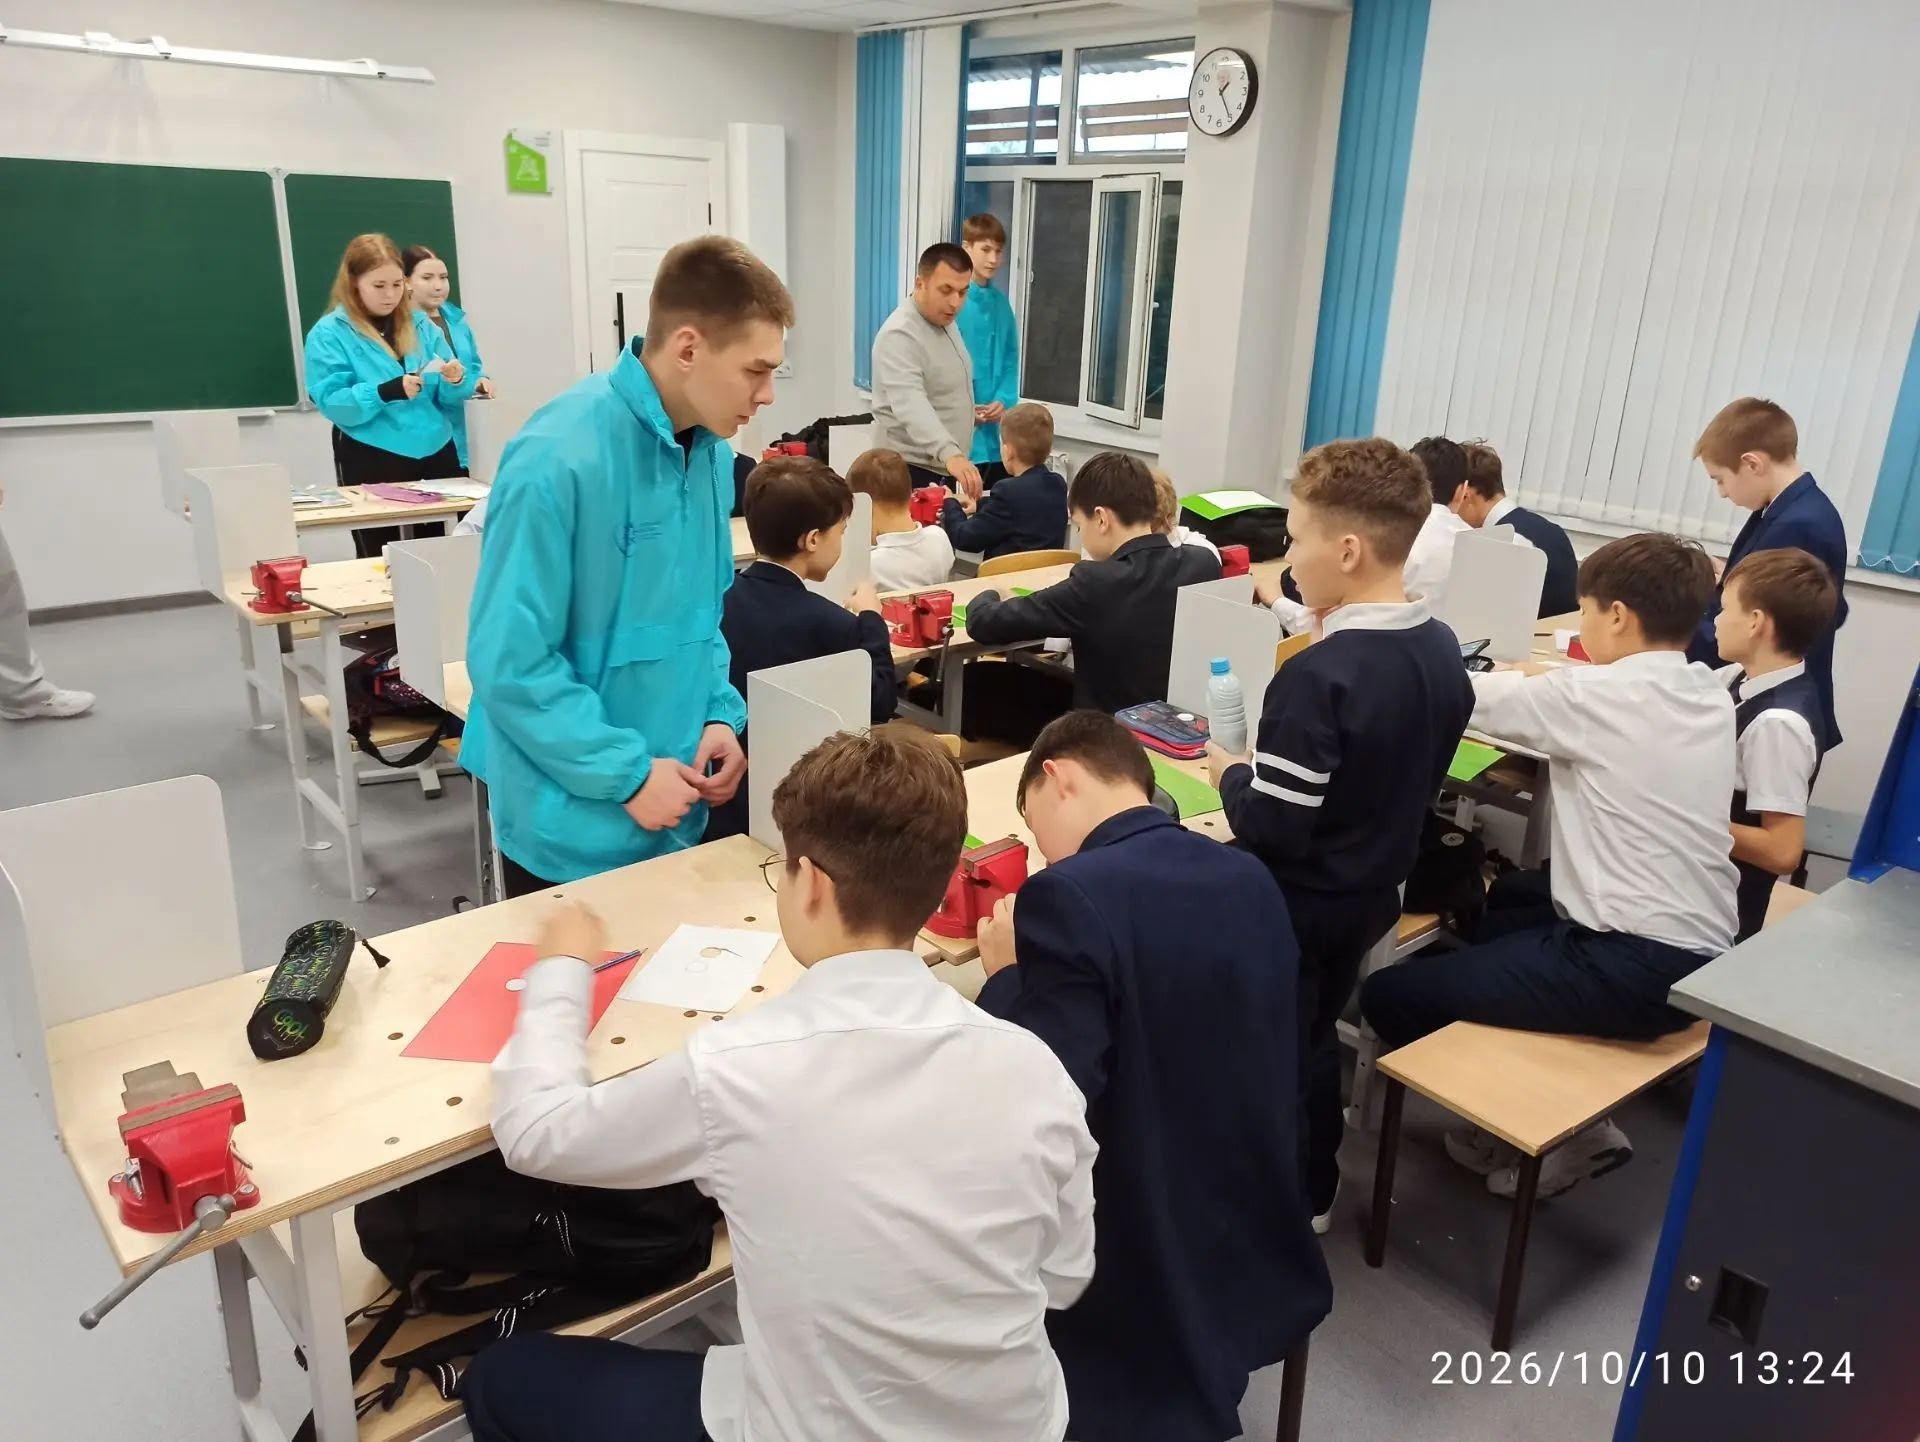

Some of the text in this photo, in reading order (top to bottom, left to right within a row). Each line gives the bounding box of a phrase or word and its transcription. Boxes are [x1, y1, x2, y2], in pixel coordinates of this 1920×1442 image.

[1202, 73, 1210, 82] 10
[1240, 71, 1246, 80] 2
[1198, 89, 1204, 98] 9
[1241, 87, 1247, 96] 3
[1200, 104, 1205, 113] 8
[1236, 102, 1242, 111] 4
[1207, 114, 1212, 124] 7
[1227, 113, 1233, 122] 5
[1216, 118, 1222, 128] 6
